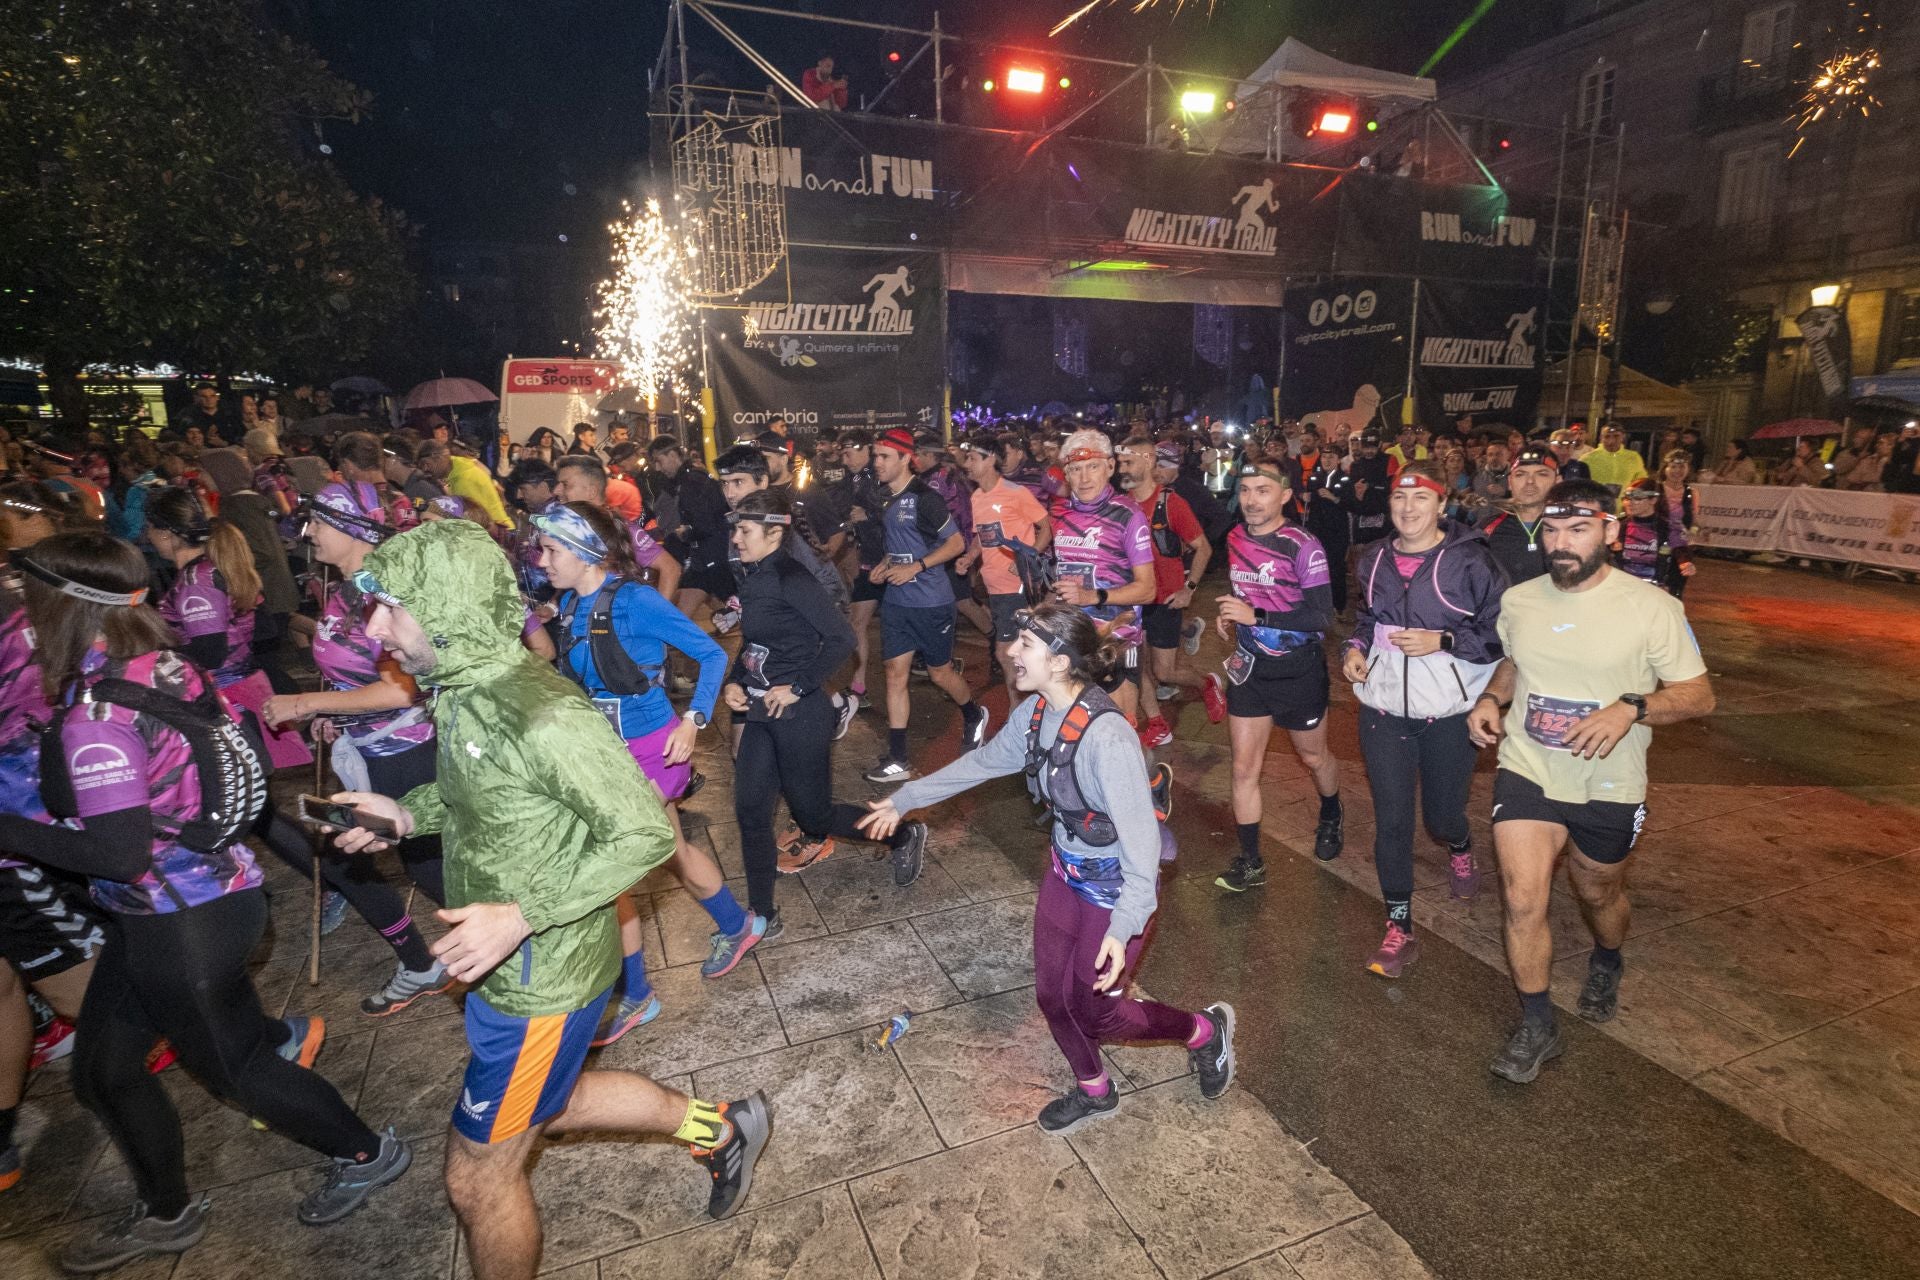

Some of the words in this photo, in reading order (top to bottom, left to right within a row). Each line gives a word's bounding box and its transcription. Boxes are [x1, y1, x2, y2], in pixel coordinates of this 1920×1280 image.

[732, 143, 801, 188] RUN
[805, 156, 871, 195] and
[869, 154, 933, 199] FUN
[1125, 207, 1233, 248] NIGHTCITY
[1233, 226, 1277, 250] TRAIL
[1421, 211, 1460, 242] RUN
[1462, 217, 1498, 247] and
[1497, 216, 1536, 246] FUN
[746, 302, 866, 331] NIGHTCITY
[866, 308, 914, 332] TRAIL
[804, 342, 853, 353] Quimera
[1420, 337, 1505, 363] NIGHTCITY
[1500, 345, 1536, 365] TRAIL
[1443, 392, 1474, 411] RUN
[1487, 390, 1517, 409] FUN
